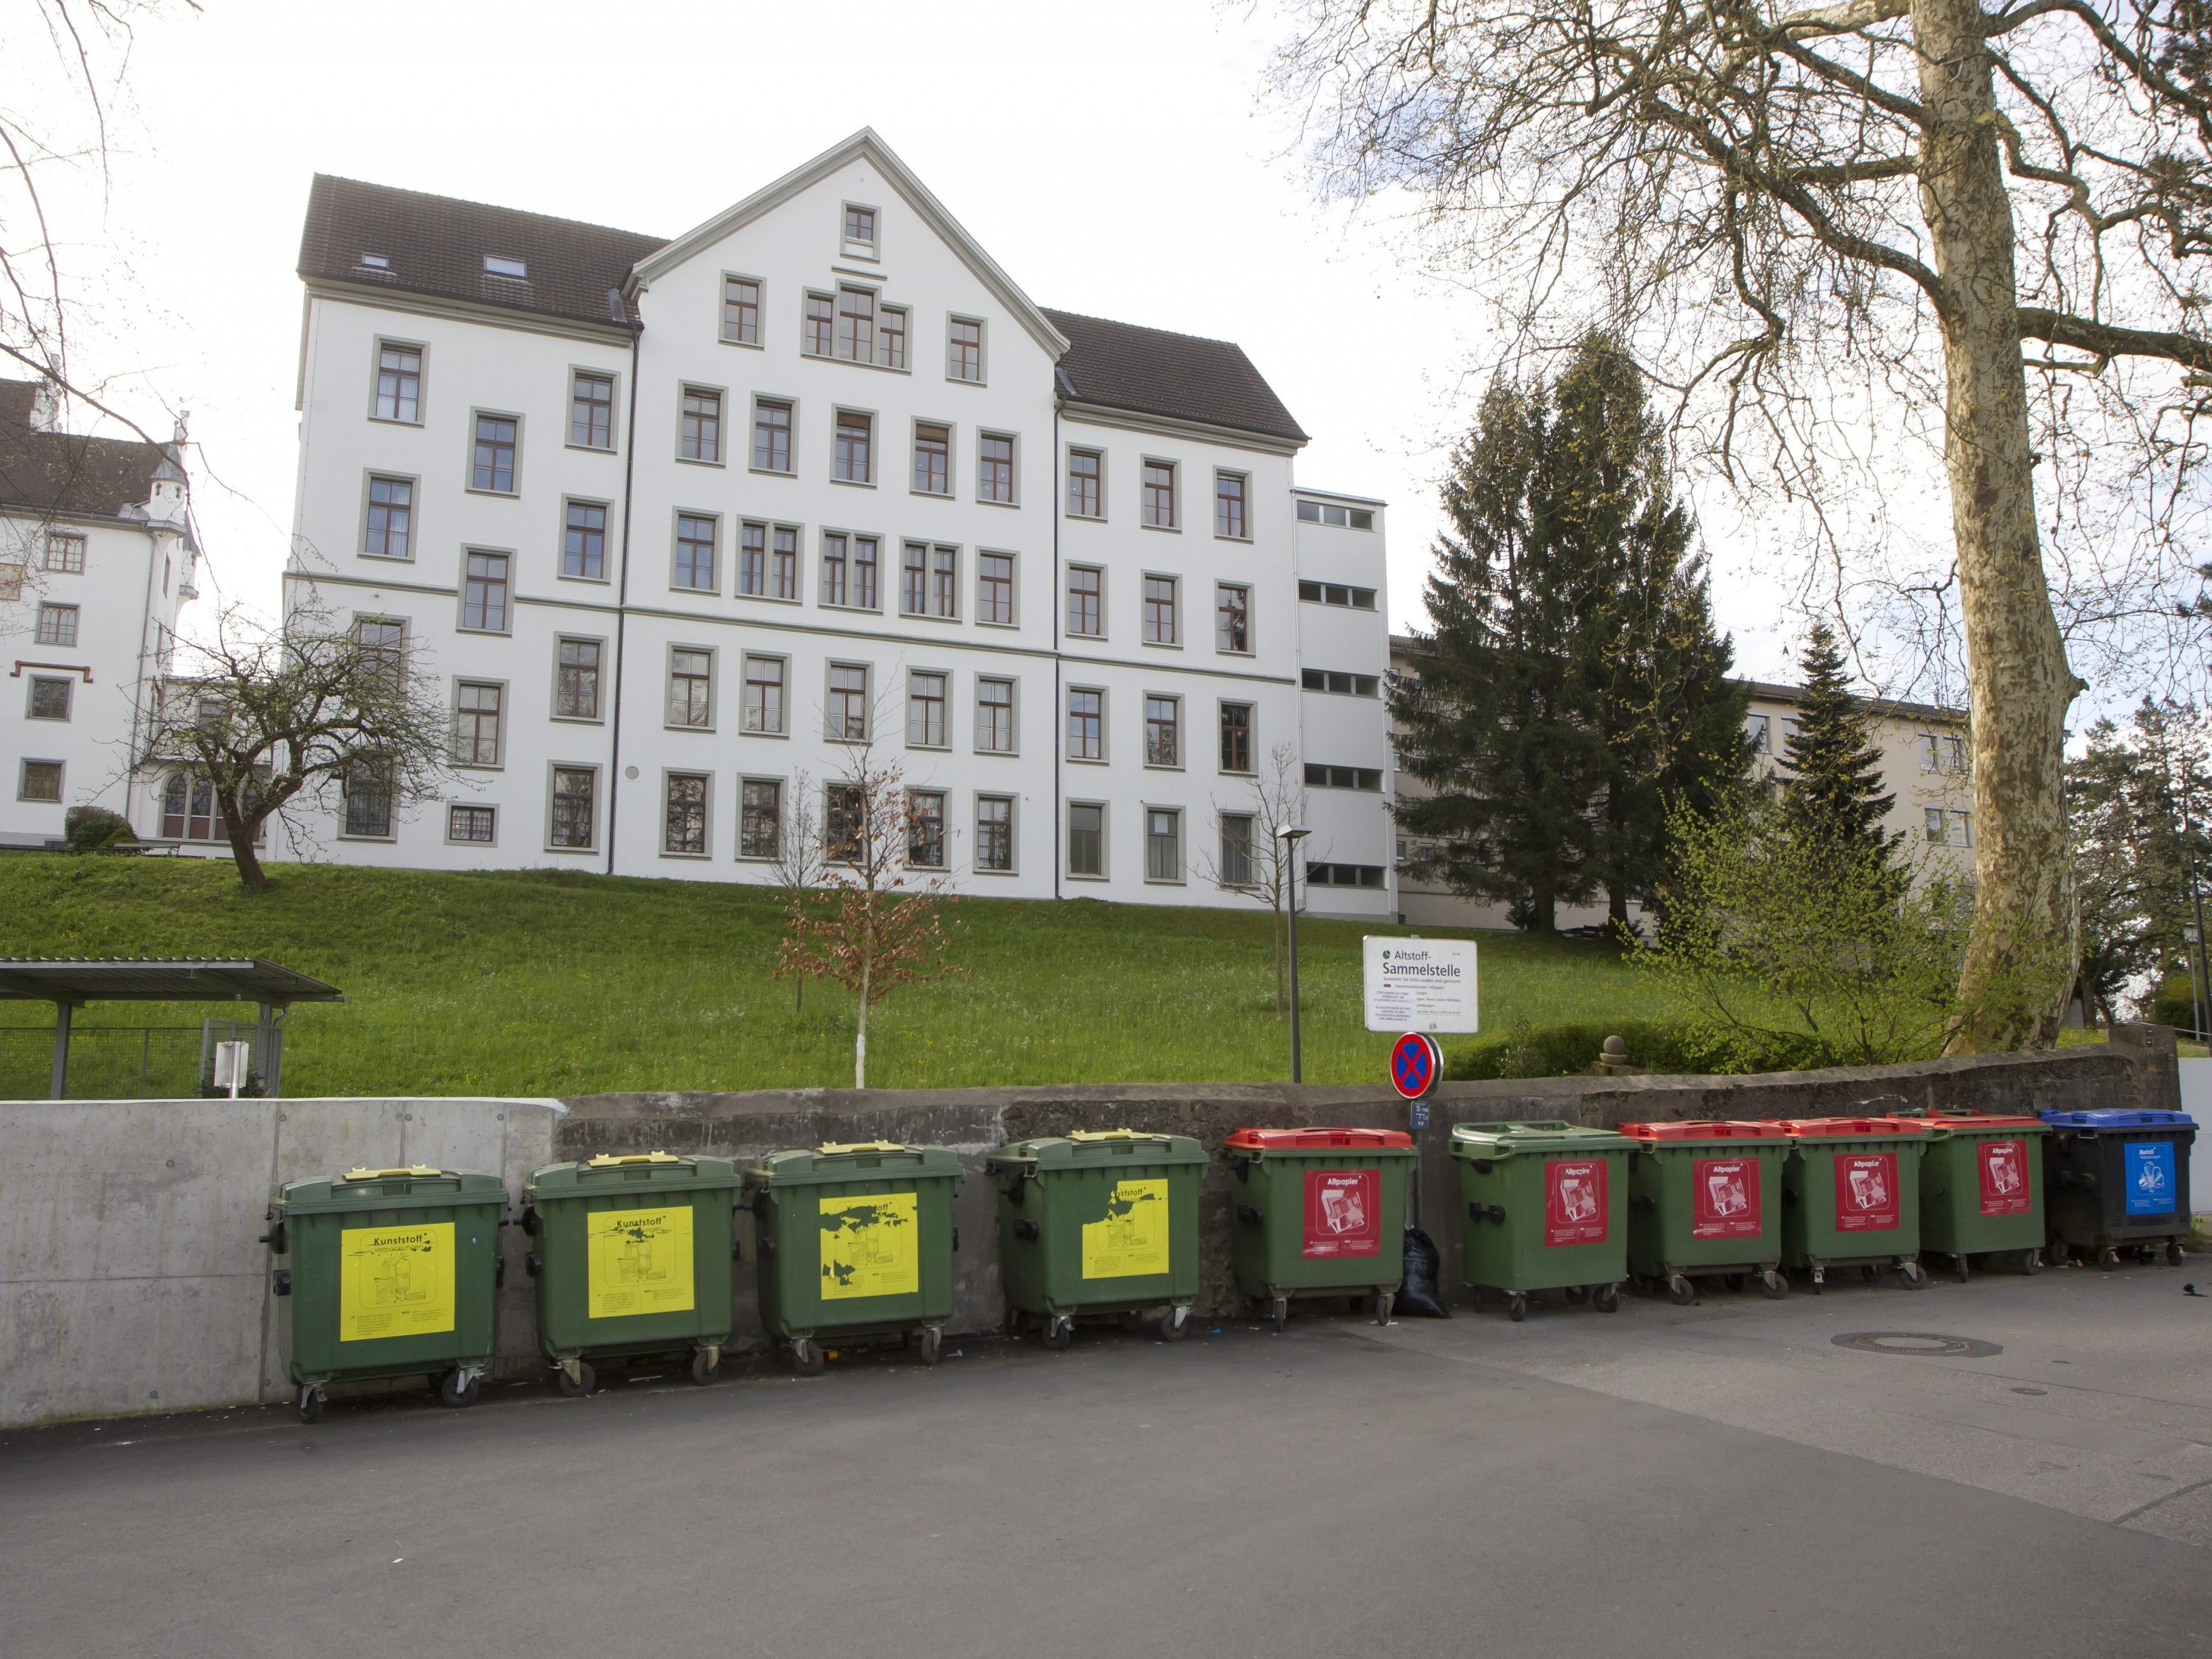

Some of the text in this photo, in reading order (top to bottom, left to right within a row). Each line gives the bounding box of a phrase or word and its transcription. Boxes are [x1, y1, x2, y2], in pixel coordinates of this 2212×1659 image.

[1394, 950, 1431, 960] Altstoff-
[1383, 962, 1460, 977] Sammelstelle
[1565, 1168, 1590, 1176] Altpapier
[1327, 1177, 1358, 1186] Altpapier
[617, 1217, 662, 1228] Kunststoff
[374, 1234, 422, 1246] Kunststoff
